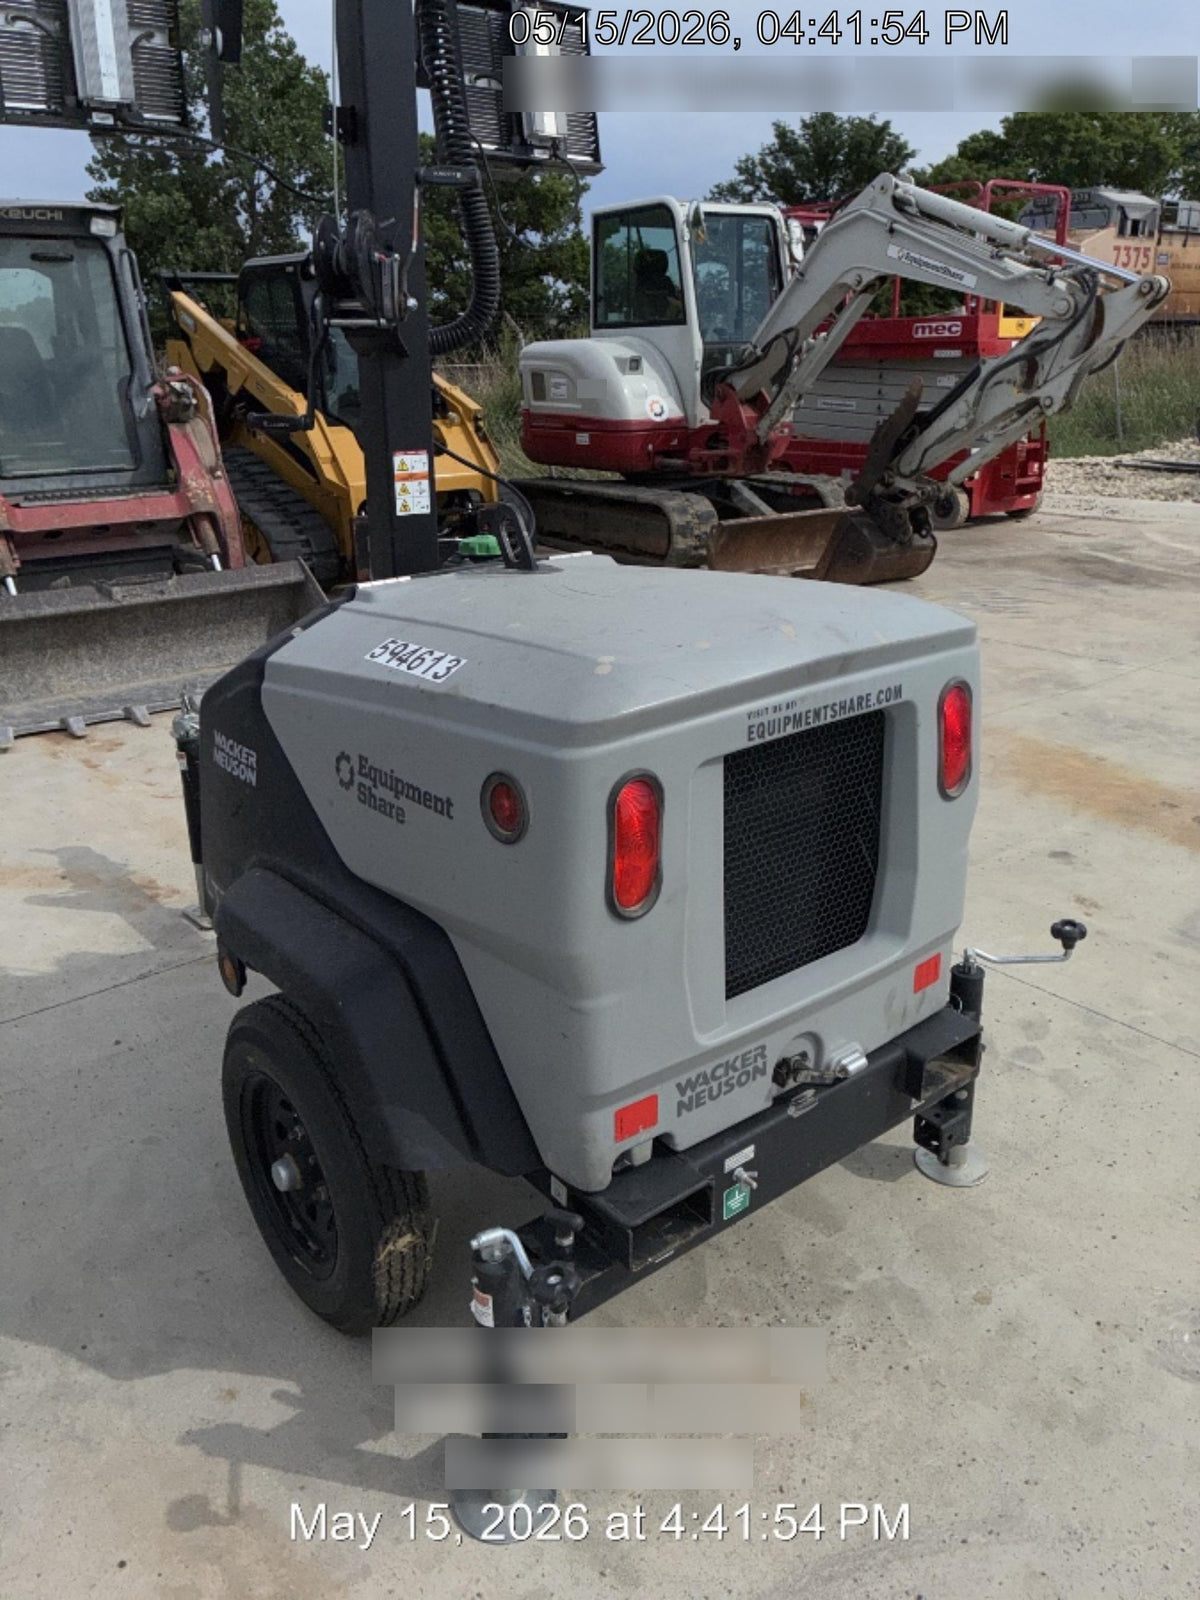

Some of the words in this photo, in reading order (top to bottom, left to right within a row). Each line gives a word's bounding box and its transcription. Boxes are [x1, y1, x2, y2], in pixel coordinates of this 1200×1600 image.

[1112, 245, 1152, 269] 7375
[914, 322, 962, 336] mec
[369, 639, 462, 680] 594613
[747, 684, 903, 742] EQUIPMENTSHARE.COM
[213, 729, 257, 769] WACKER
[213, 746, 257, 787] NEUSON
[357, 781, 406, 824] Share
[358, 754, 454, 820] Equipment
[675, 1044, 767, 1098] WACKER
[676, 1061, 767, 1118] NEUSON
